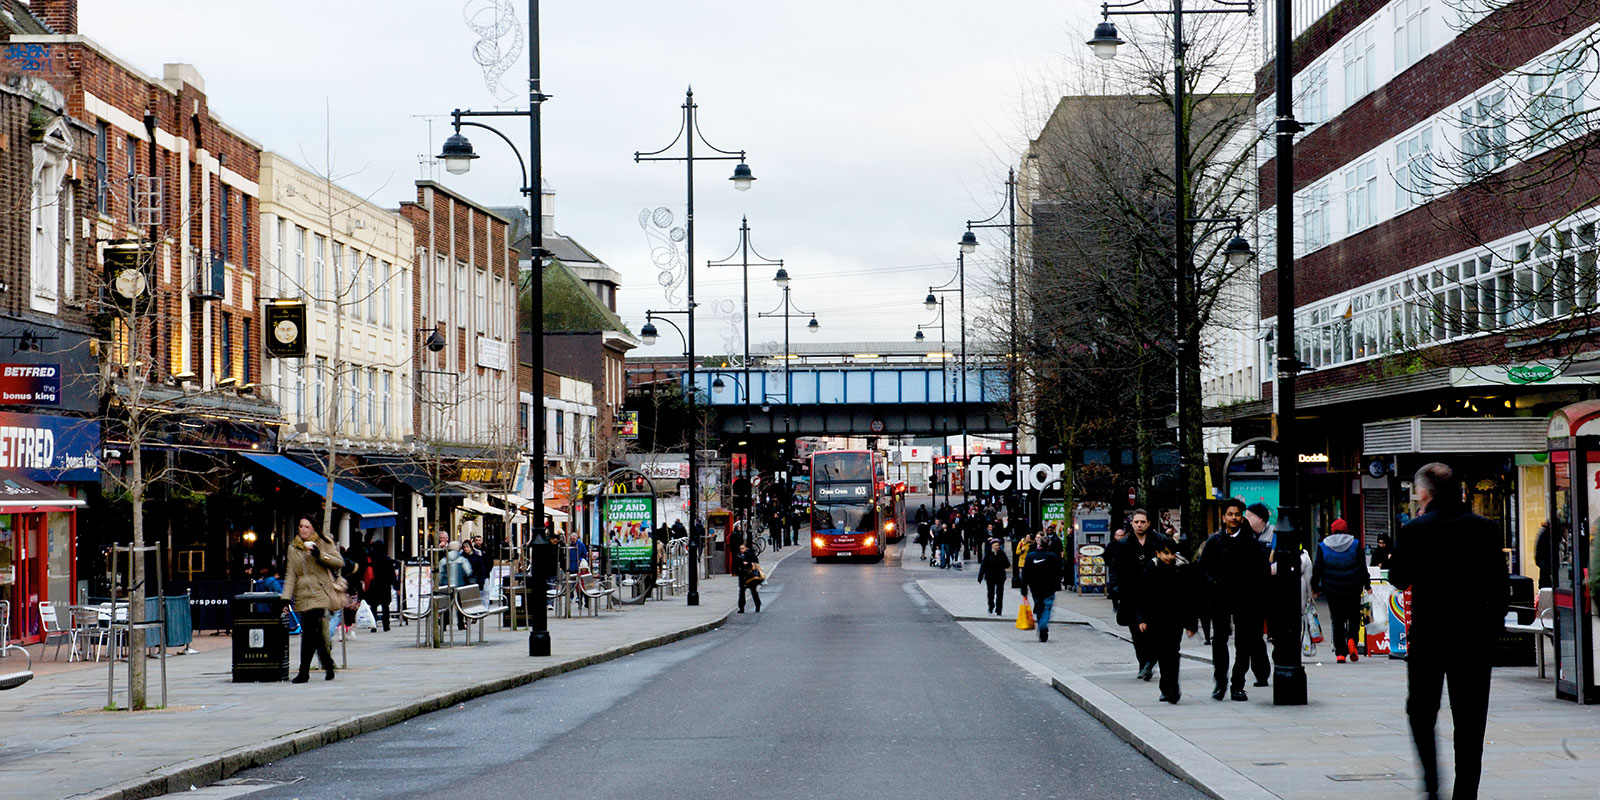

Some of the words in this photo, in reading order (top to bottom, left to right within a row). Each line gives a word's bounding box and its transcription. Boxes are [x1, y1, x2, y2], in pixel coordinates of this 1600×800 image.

[4, 367, 56, 377] BETFRED
[43, 385, 56, 393] the
[3, 392, 32, 400] bonus
[35, 392, 56, 401] king
[0, 426, 54, 469] ETFRED
[1299, 453, 1328, 463] Doddle
[855, 486, 866, 495] 103
[610, 504, 624, 512] UP
[625, 504, 647, 512] AND
